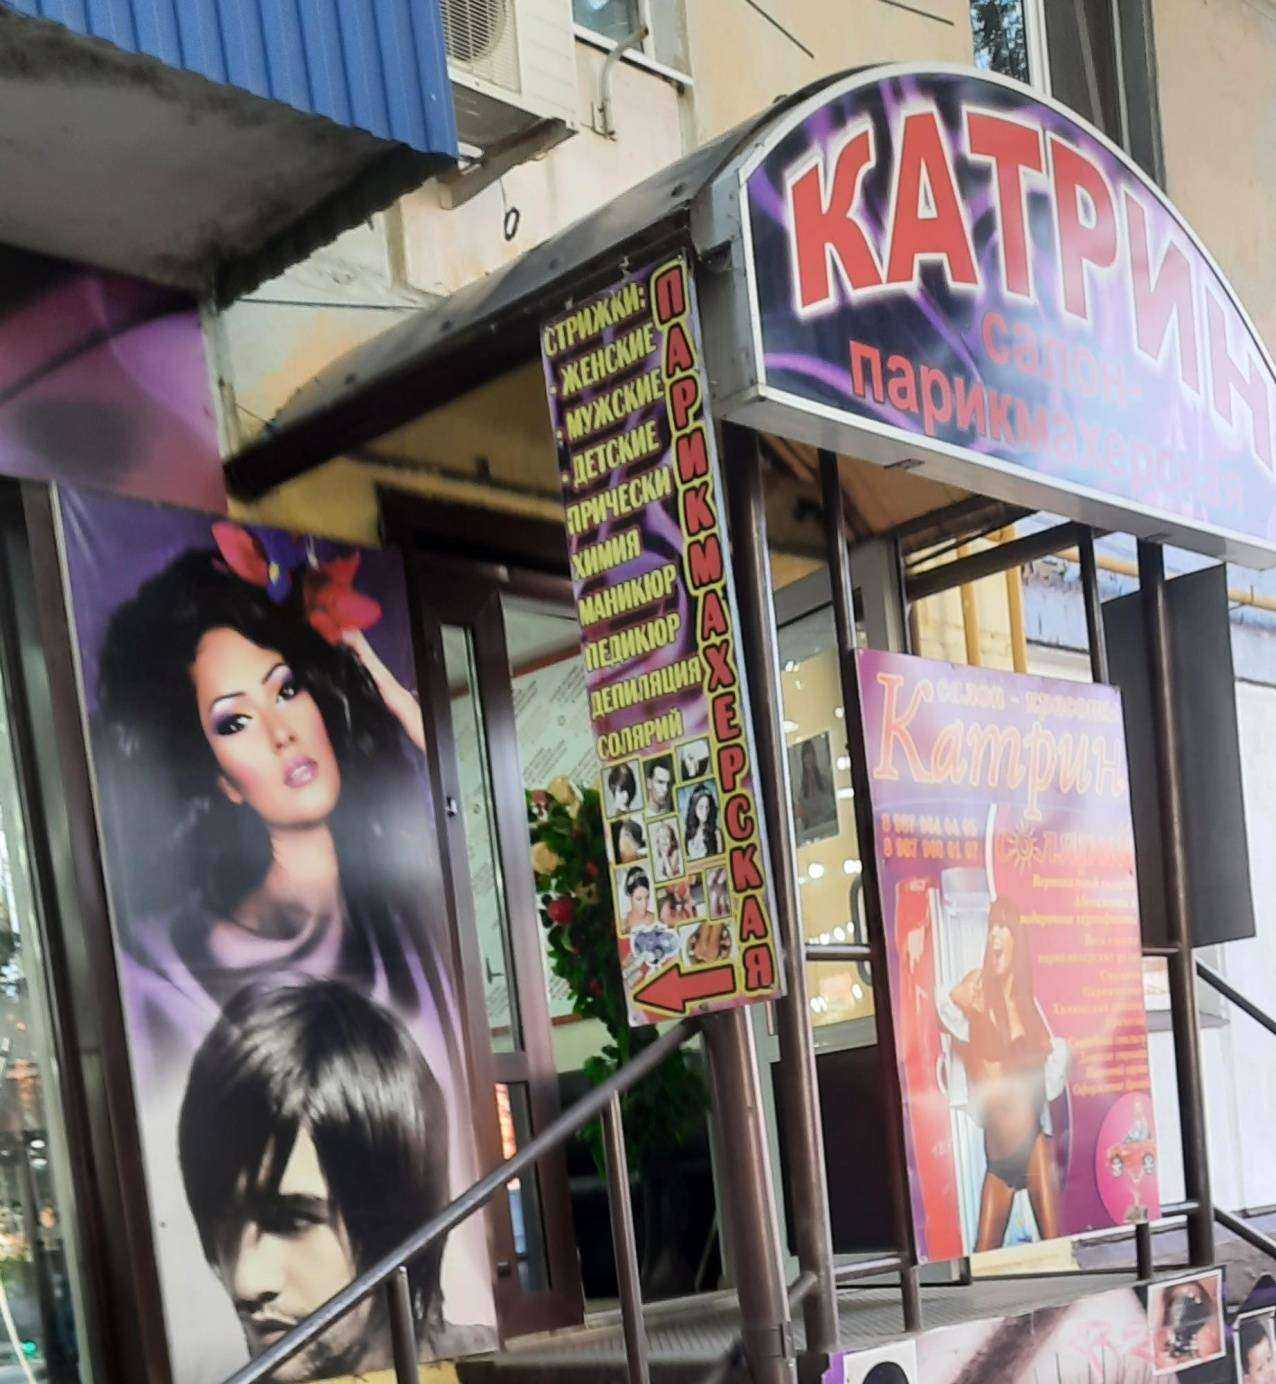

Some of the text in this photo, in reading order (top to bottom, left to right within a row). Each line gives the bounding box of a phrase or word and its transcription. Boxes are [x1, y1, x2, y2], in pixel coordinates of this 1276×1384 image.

[544, 282, 647, 355] СТРИЖКИ:
[788, 106, 1276, 472] КАТРИН
[561, 322, 656, 397] ЖЕНСКИЕ
[566, 368, 664, 440] МУЖСКИЕ
[573, 420, 660, 489] ДЕТСКИЕ
[566, 466, 672, 536] ПРИЧЕСКИ
[571, 529, 642, 580] ХИМИЯ
[578, 563, 677, 627] МАНИКЮР
[652, 260, 776, 993] ПАРИКМАХЕРСКАЯ
[584, 612, 681, 672] ПЕДИКЮР
[591, 656, 701, 720] ДЕПИЛЯЦИЯ
[598, 708, 684, 758] СОЛЯРИЙ
[873, 672, 1127, 821] Катрин
